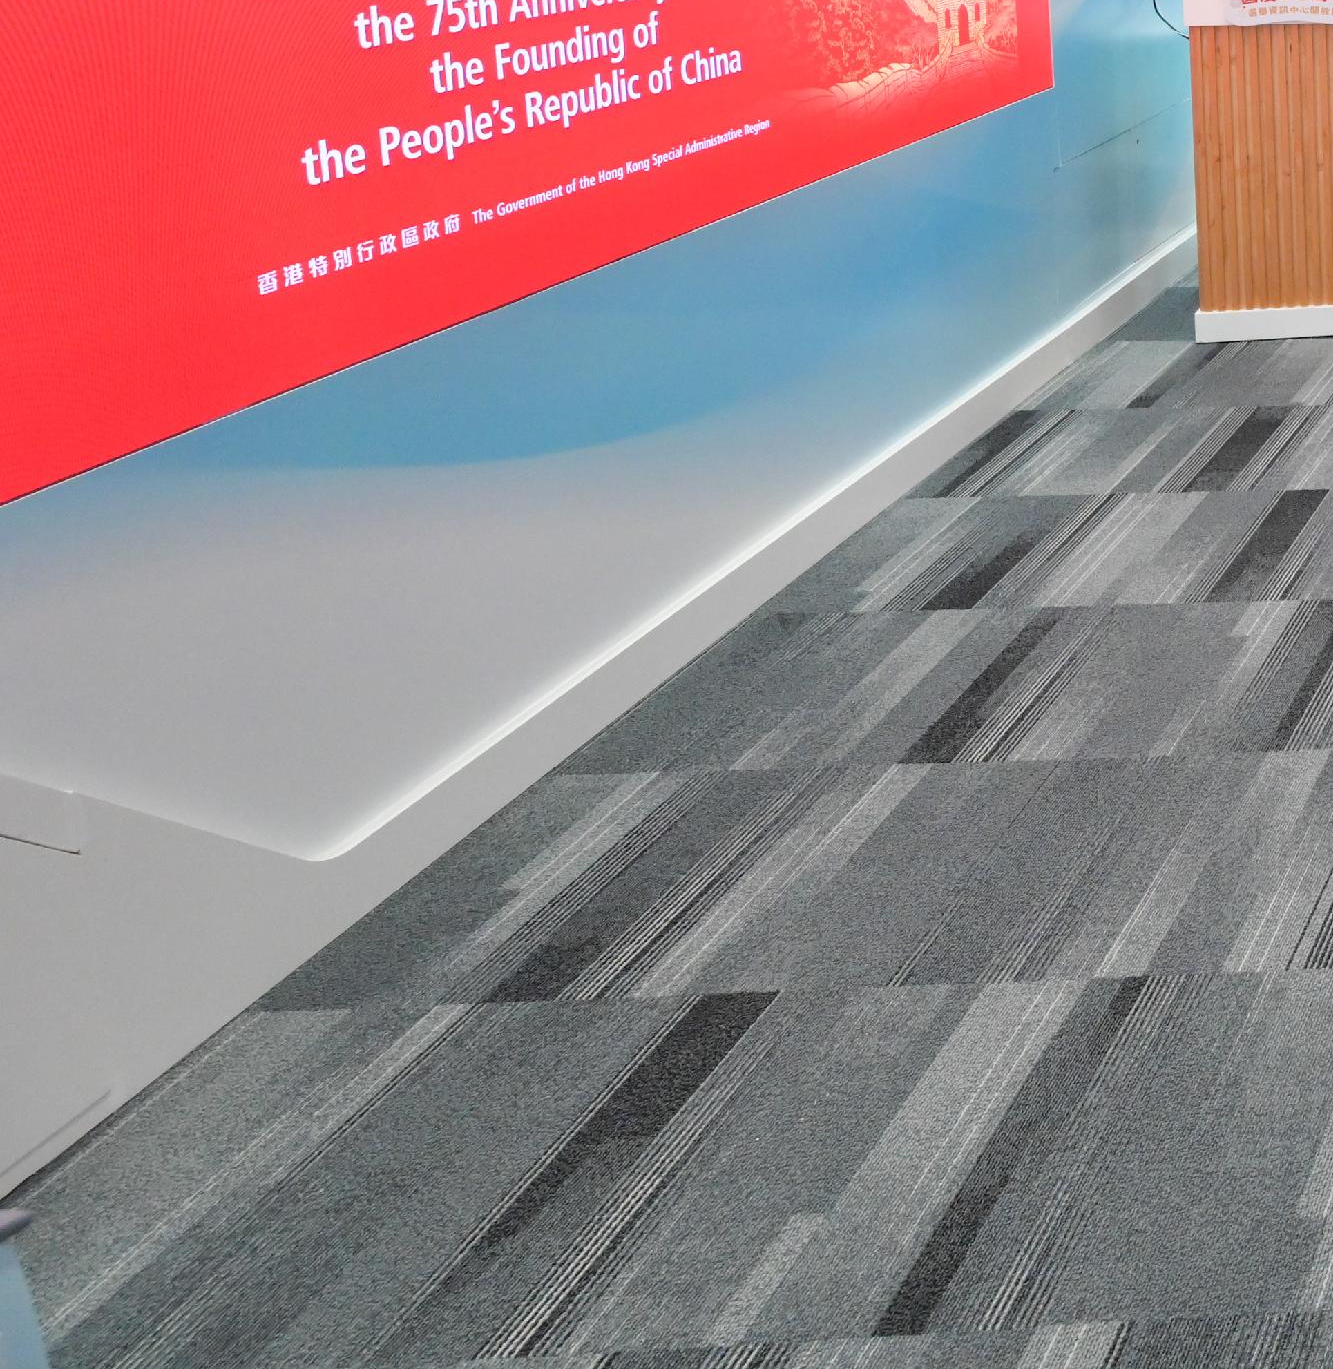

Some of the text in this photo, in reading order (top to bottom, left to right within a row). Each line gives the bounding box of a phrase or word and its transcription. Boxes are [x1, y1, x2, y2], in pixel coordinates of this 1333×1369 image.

[354, 5, 414, 49] the
[430, 11, 660, 94] the Founding of
[301, 46, 743, 186] the People's Republic of China
[472, 119, 770, 225] The Government of the Hong Kong Special Administrative Region
[257, 214, 460, 295] 香港特別行政區政府
